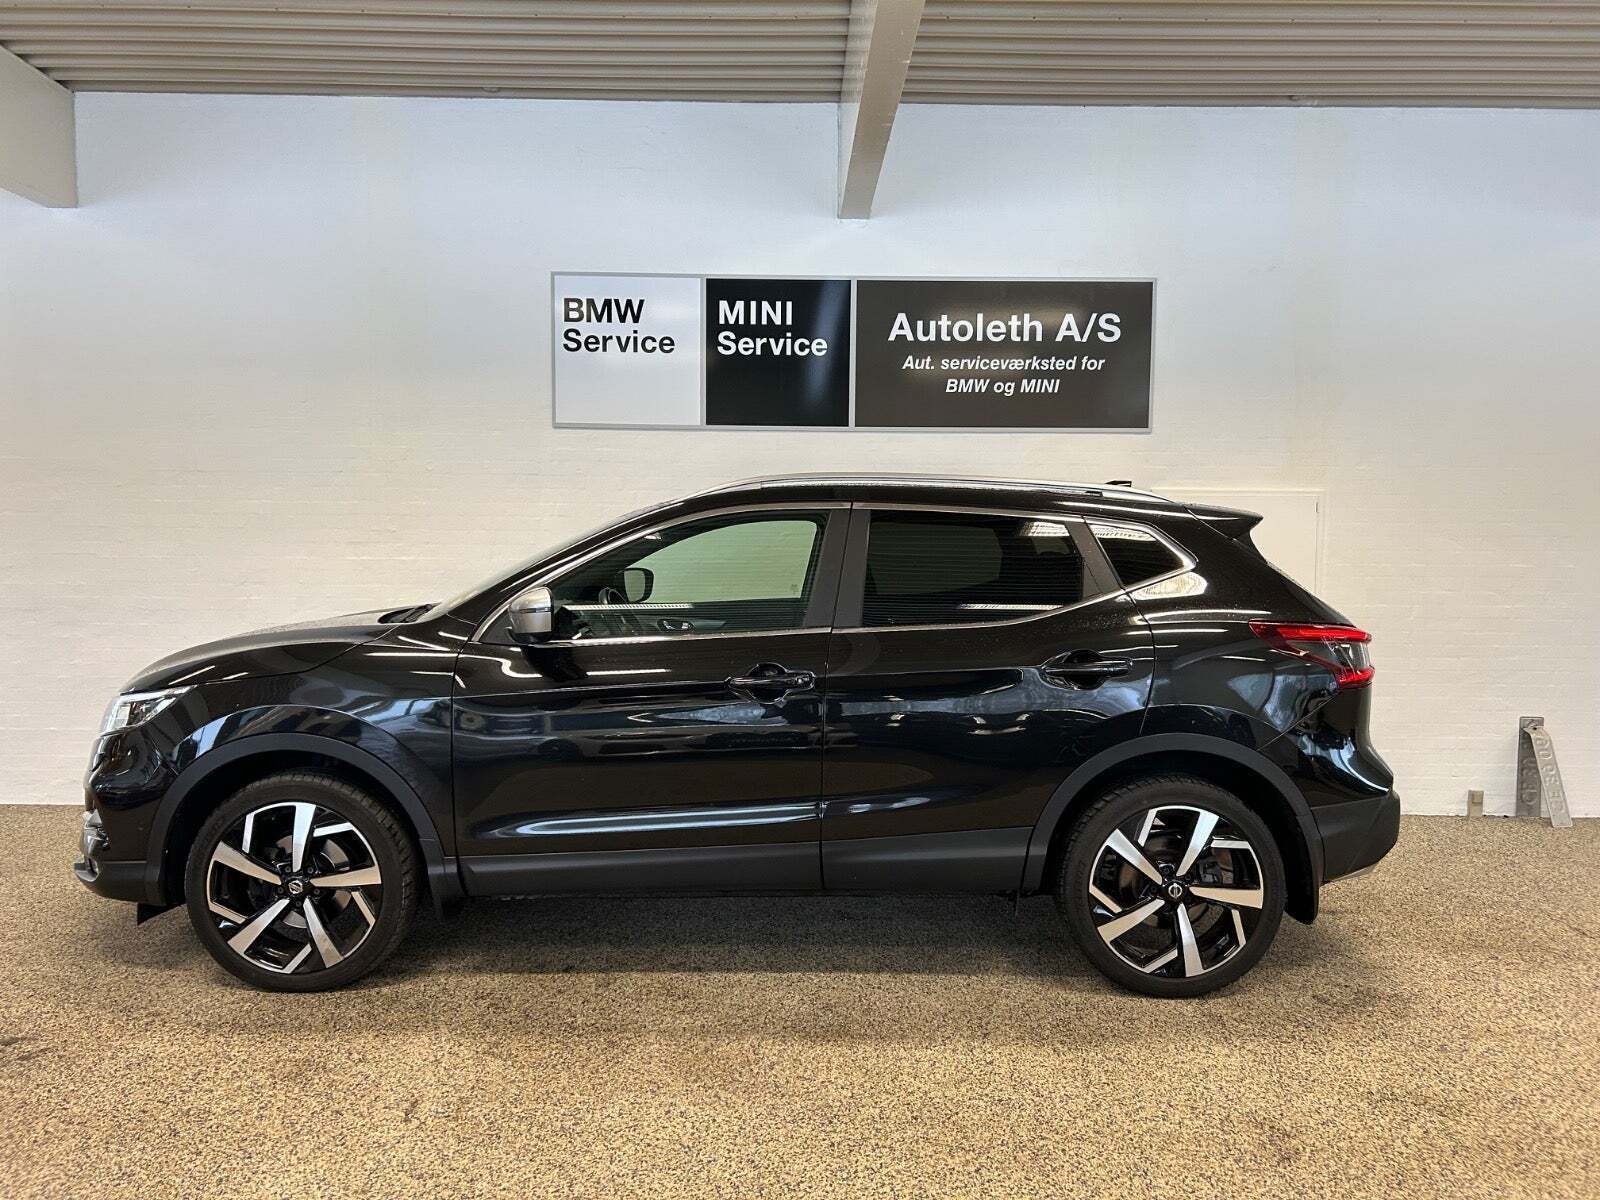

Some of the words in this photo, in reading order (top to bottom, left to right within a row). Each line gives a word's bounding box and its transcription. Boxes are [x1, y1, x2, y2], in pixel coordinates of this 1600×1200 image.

[563, 297, 645, 324] BMW
[718, 300, 793, 326] MINI
[562, 327, 676, 354] Service
[887, 312, 1043, 342] Autoleth
[1055, 312, 1121, 343] A/S
[717, 330, 828, 357] Service
[901, 355, 935, 371] Aut.
[940, 355, 1078, 371] serviceværksted
[1081, 355, 1106, 371] for
[945, 378, 991, 393] BMW
[993, 381, 1016, 397] og
[1020, 378, 1061, 393] MINI
